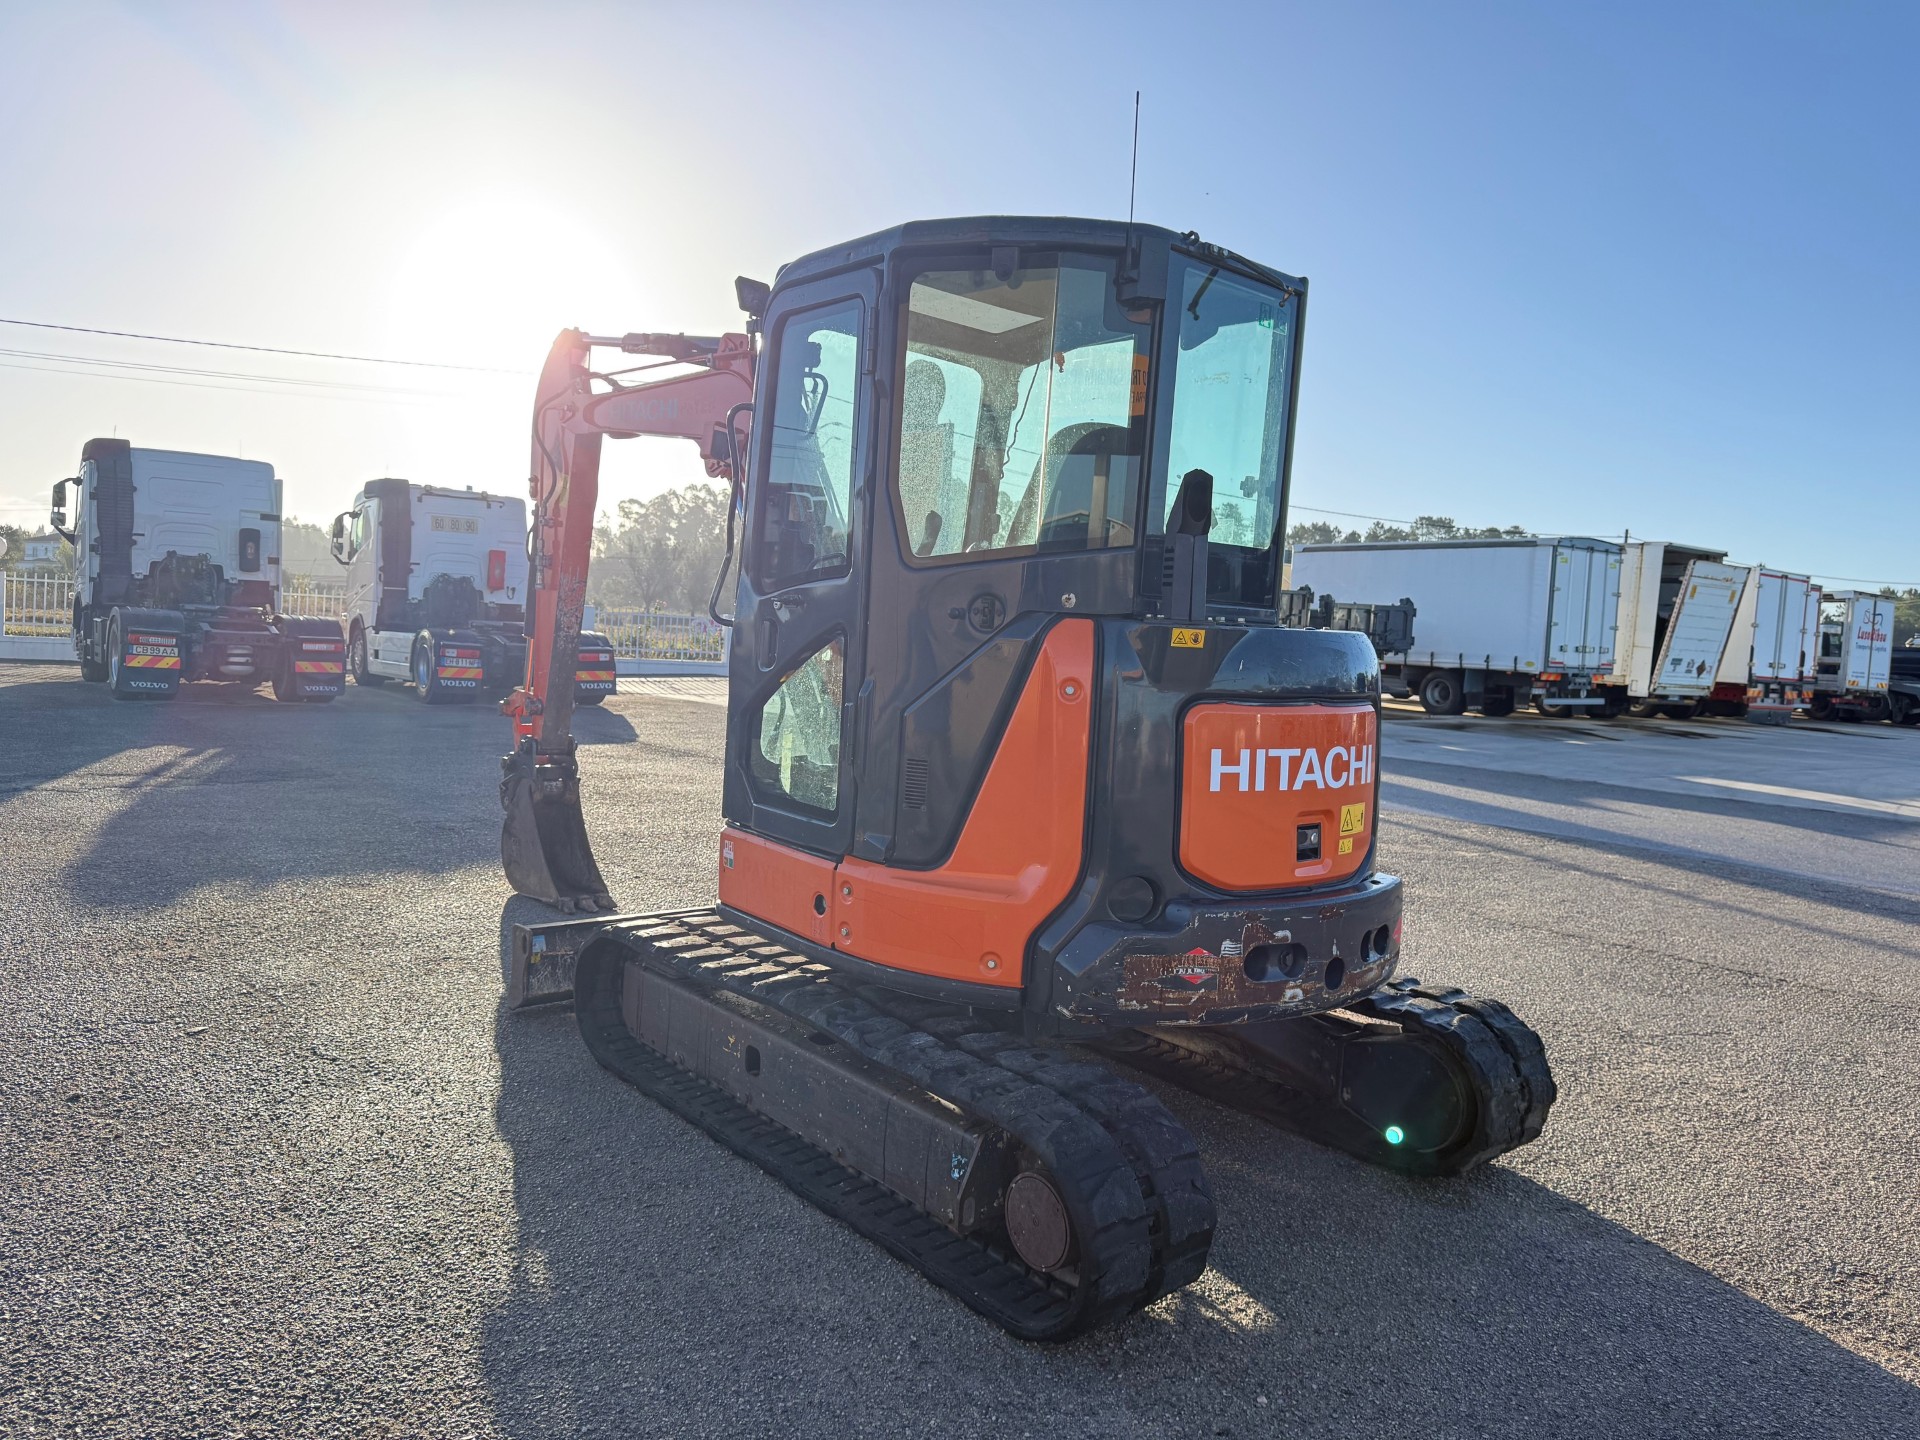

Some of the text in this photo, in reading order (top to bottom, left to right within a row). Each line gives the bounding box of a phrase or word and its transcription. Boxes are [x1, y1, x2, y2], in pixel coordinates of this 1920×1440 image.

[130, 681, 169, 689] VOLVO
[440, 680, 476, 688] VOLVO
[580, 682, 613, 690] VOLVO
[1209, 744, 1373, 792] HITACHI
